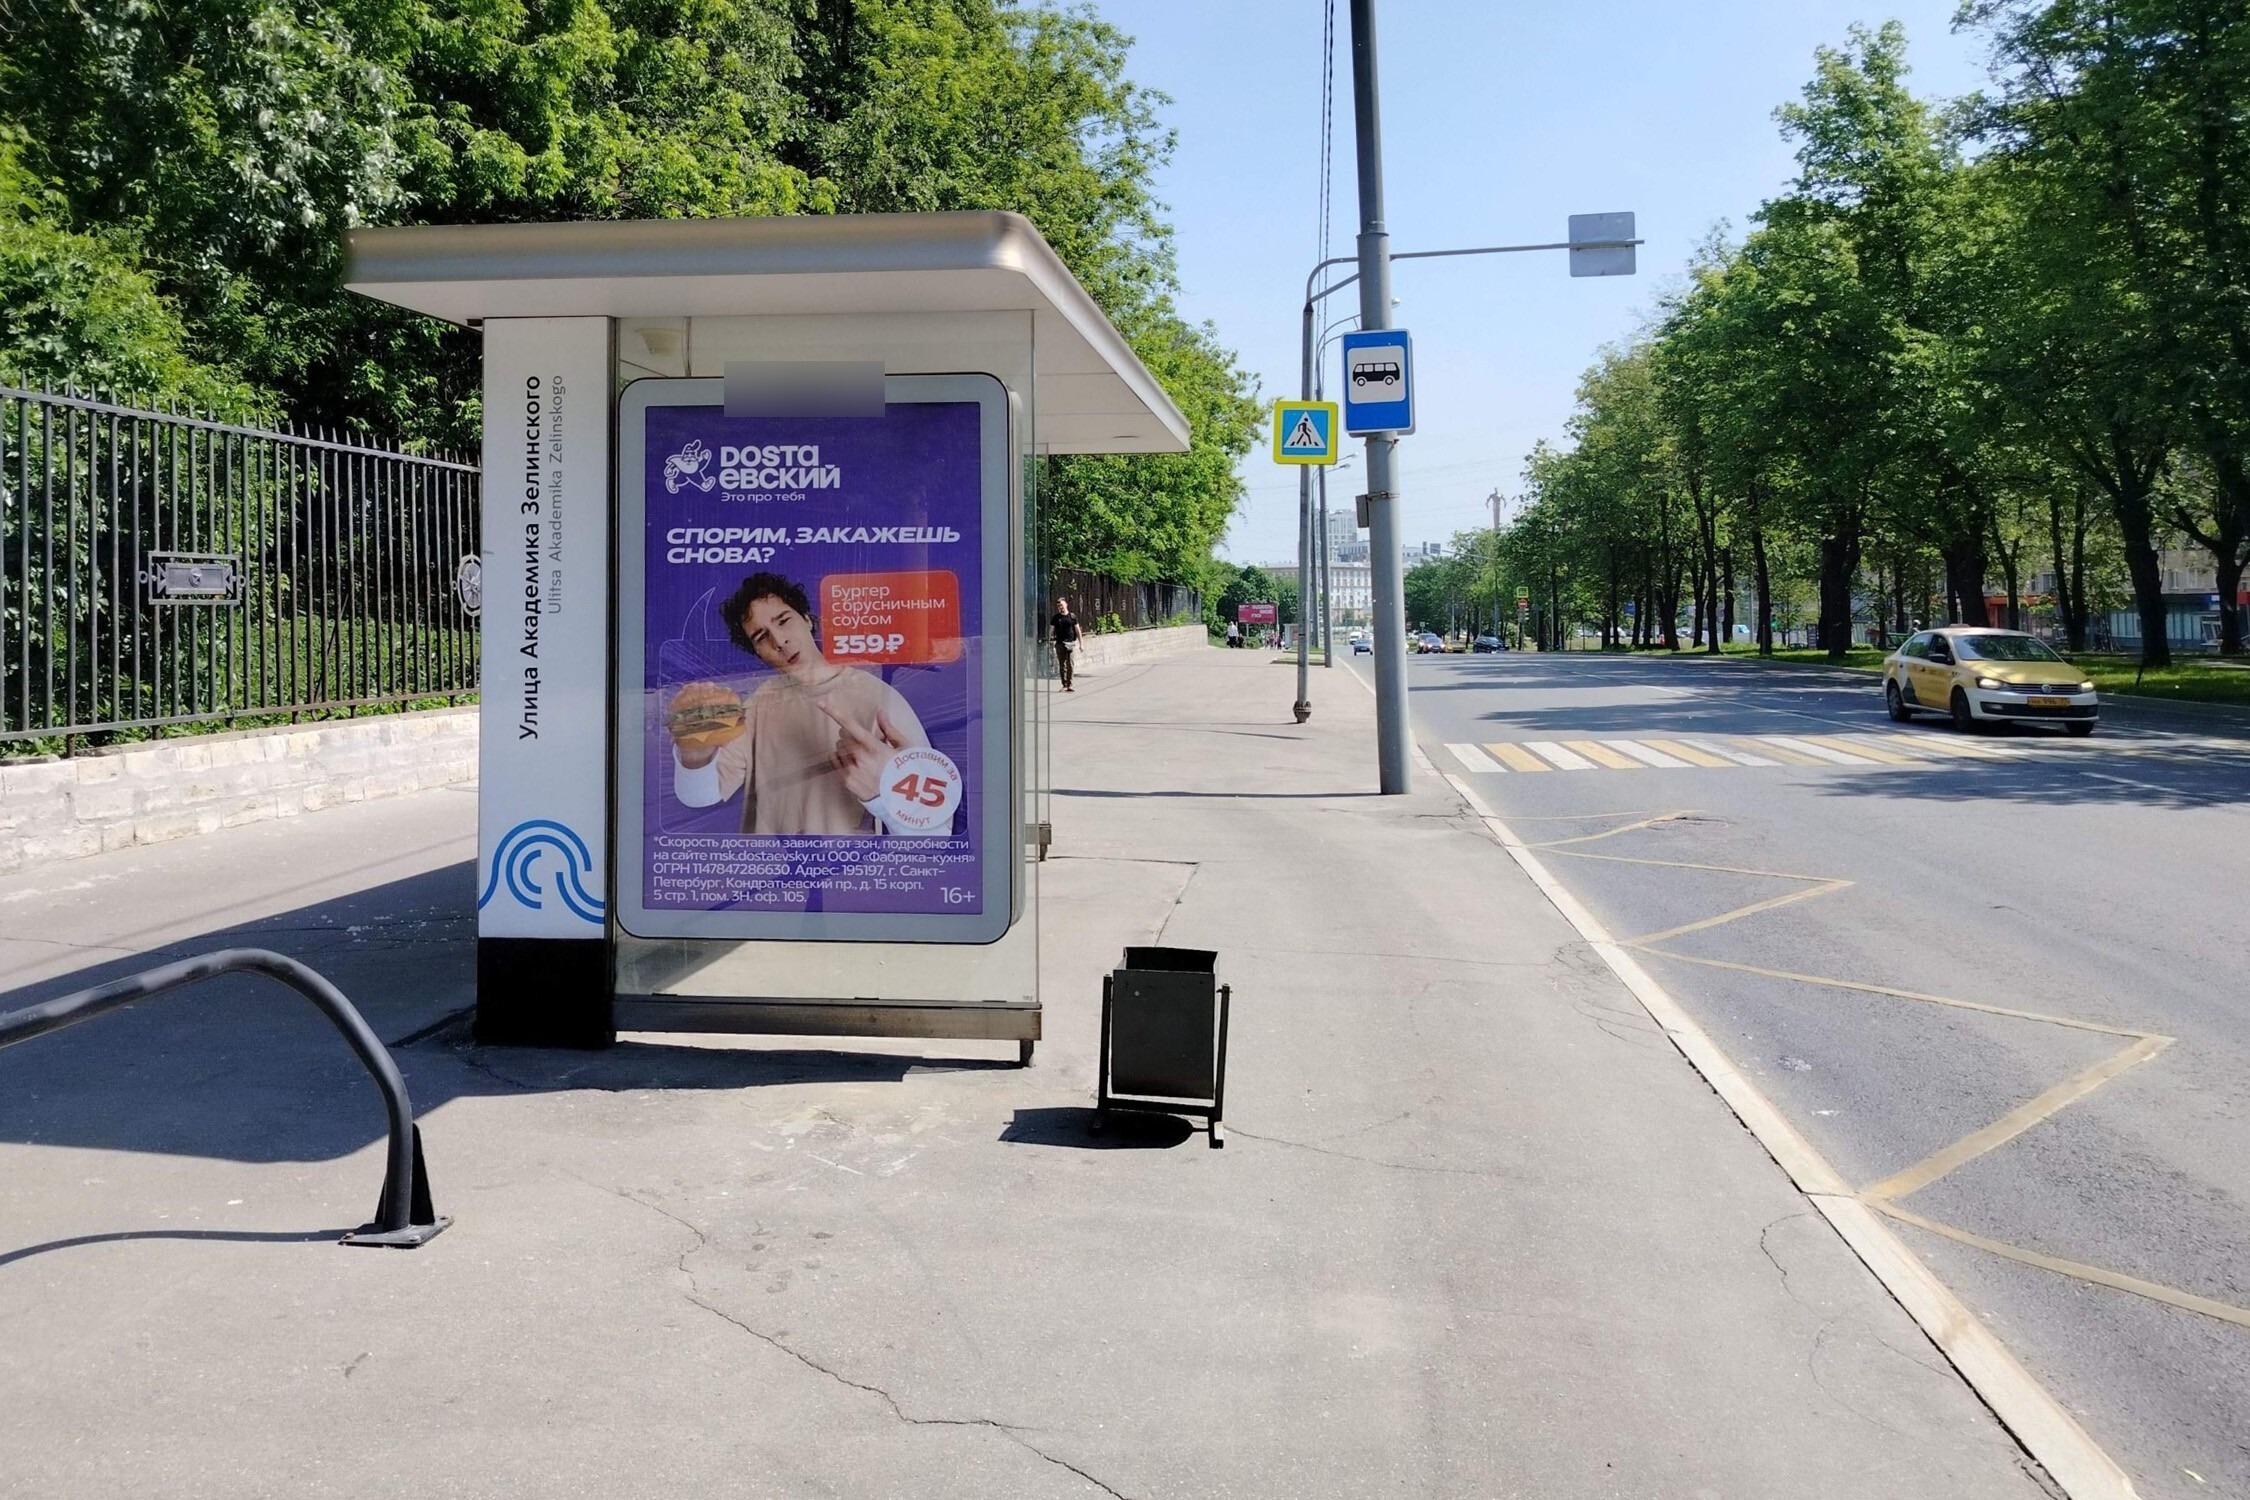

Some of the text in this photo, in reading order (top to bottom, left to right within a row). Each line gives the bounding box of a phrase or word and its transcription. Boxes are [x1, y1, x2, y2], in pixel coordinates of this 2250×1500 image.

[548, 375, 565, 614] Ulitsa Akademika Zelinskogo
[721, 492, 805, 504] Это про тебя
[666, 526, 960, 546] СПОРИМ, ЗАКАЖЕШЬ
[519, 376, 541, 740] Улица Академика Зелинского
[666, 547, 775, 564] СНОВА?
[832, 585, 890, 600] Бургер
[832, 598, 945, 616] с брусничным
[833, 614, 892, 629] соусом
[833, 633, 904, 655] 359₽
[894, 752, 958, 781] Доставим за
[892, 773, 948, 807] 45
[896, 809, 930, 827] минут
[721, 839, 780, 849] доставки
[783, 840, 833, 849] зависит
[837, 840, 850, 849] от
[854, 840, 880, 850] зон,
[883, 838, 969, 851] подробности
[653, 852, 669, 860] на
[671, 850, 707, 860] сайте
[710, 850, 825, 863] msk.dostaevsky.ru
[828, 852, 860, 862] ООО
[653, 863, 690, 874] ОГРН
[692, 863, 793, 875] 1147847286630.
[795, 865, 839, 877] Адрес:
[888, 868, 897, 876] г.
[654, 876, 724, 890] Петербург,
[726, 878, 832, 890] Кондратьевский
[860, 881, 871, 891] д.
[874, 879, 887, 890] 15
[890, 881, 924, 892] корп.
[653, 890, 662, 900] 5
[664, 892, 688, 903] стр.
[691, 890, 698, 902] 1,
[755, 891, 779, 903] оф.
[940, 887, 976, 903] 16+
